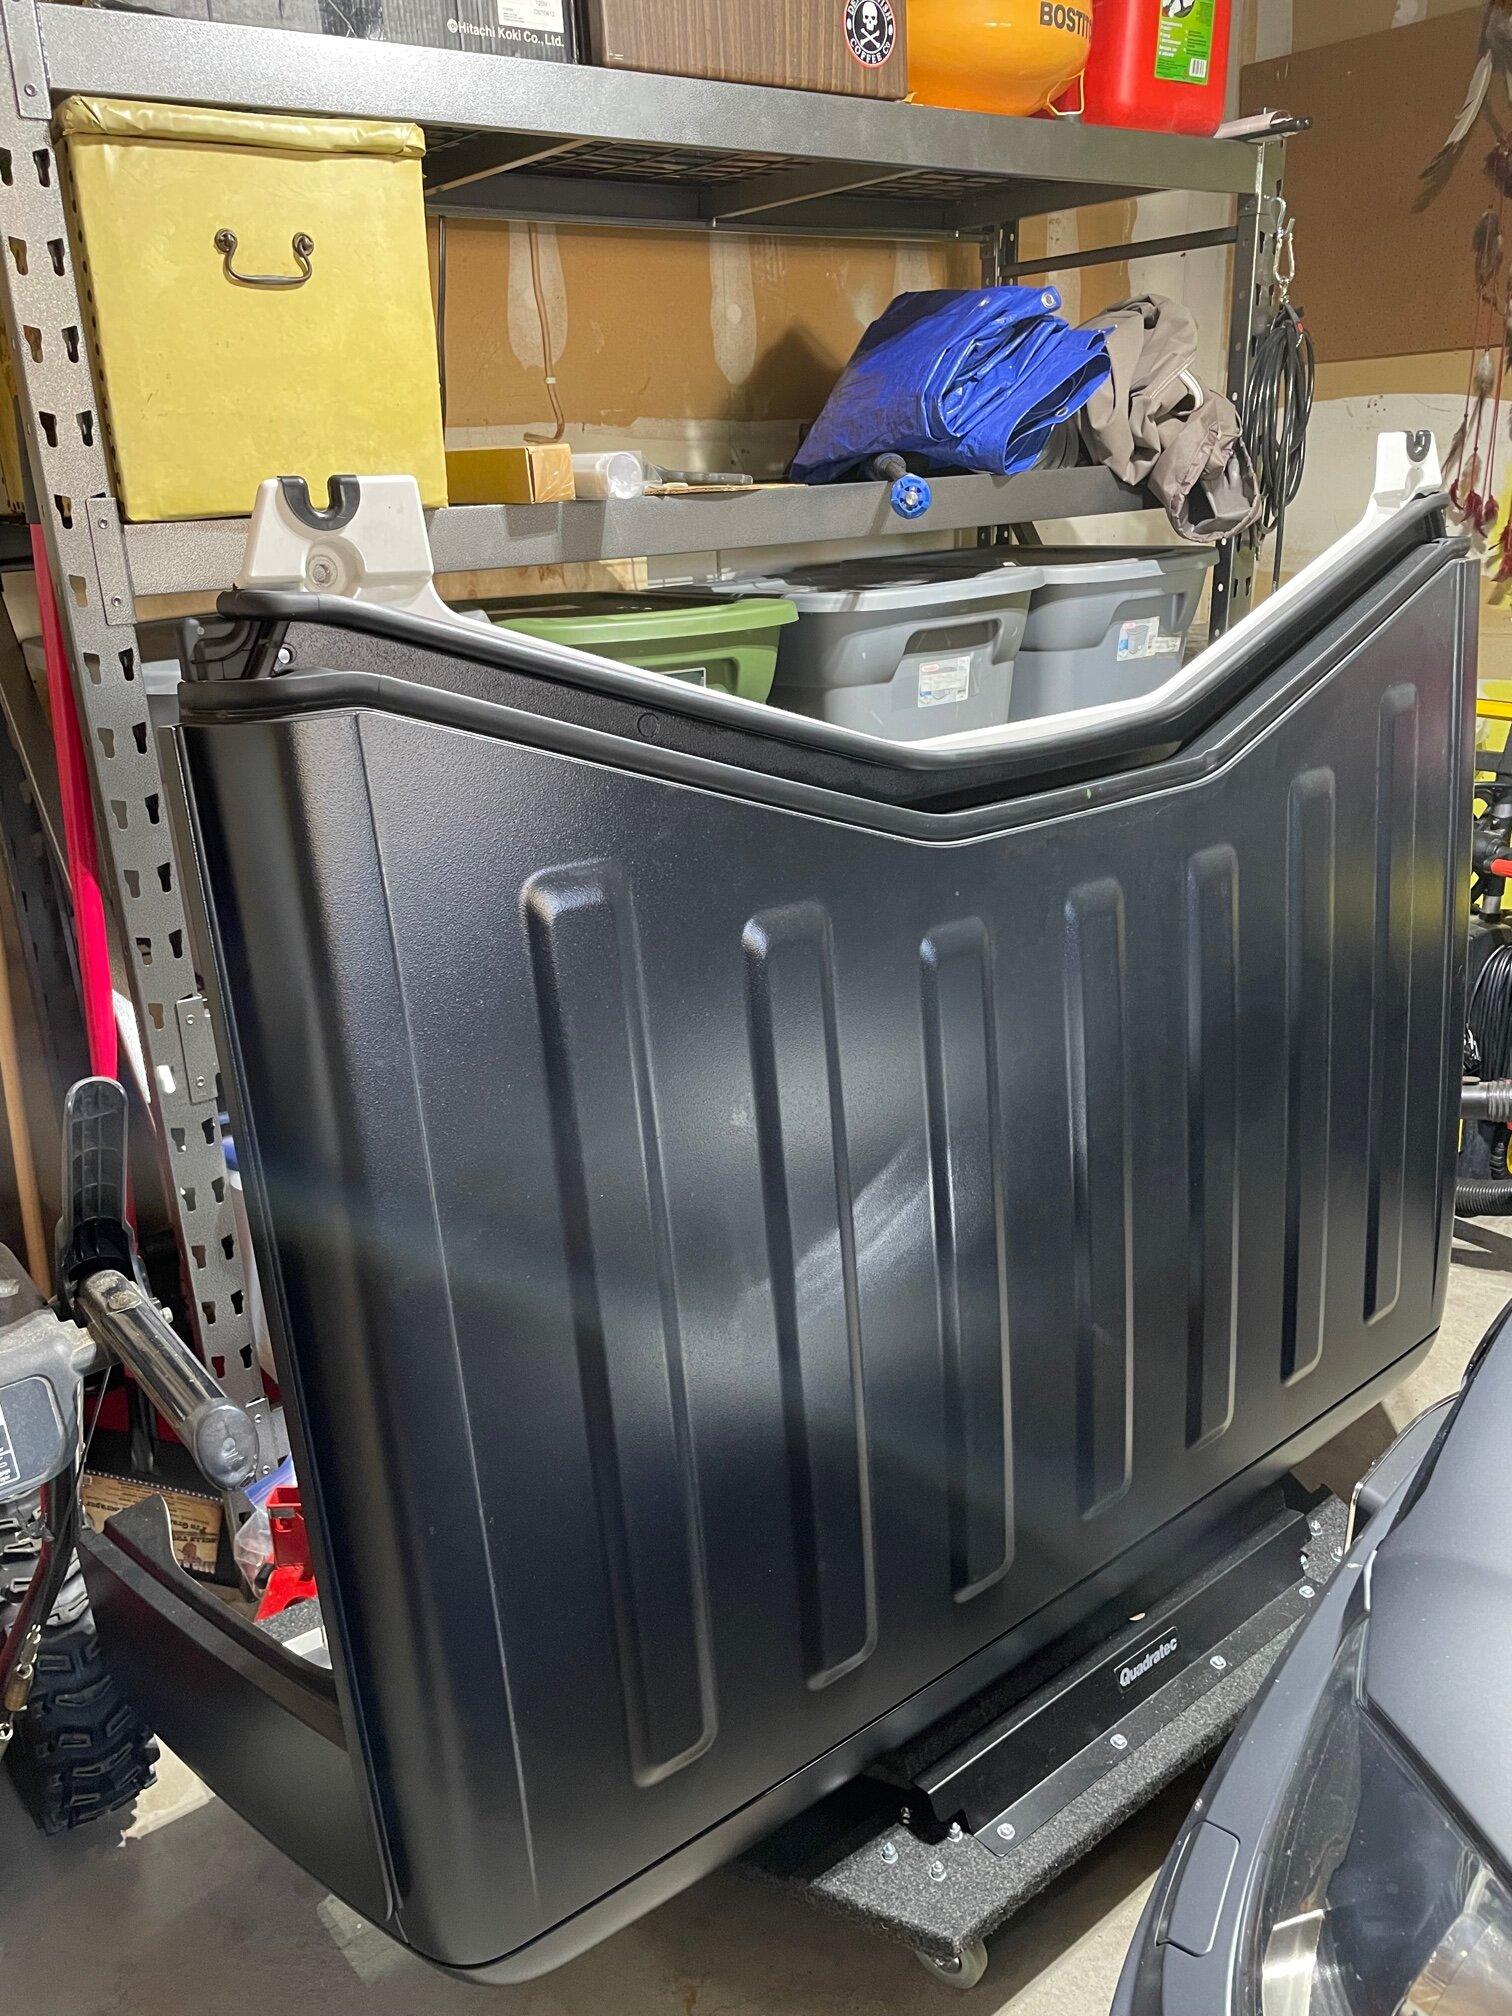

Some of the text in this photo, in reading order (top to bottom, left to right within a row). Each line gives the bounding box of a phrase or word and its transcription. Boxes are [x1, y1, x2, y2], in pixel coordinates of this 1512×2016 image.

[458, 21, 496, 39] Hitachi
[498, 27, 522, 42] Koki
[544, 34, 565, 48] Ltd.
[850, 38, 882, 64] COFFEE
[1119, 1638, 1178, 1687] Quadratec
